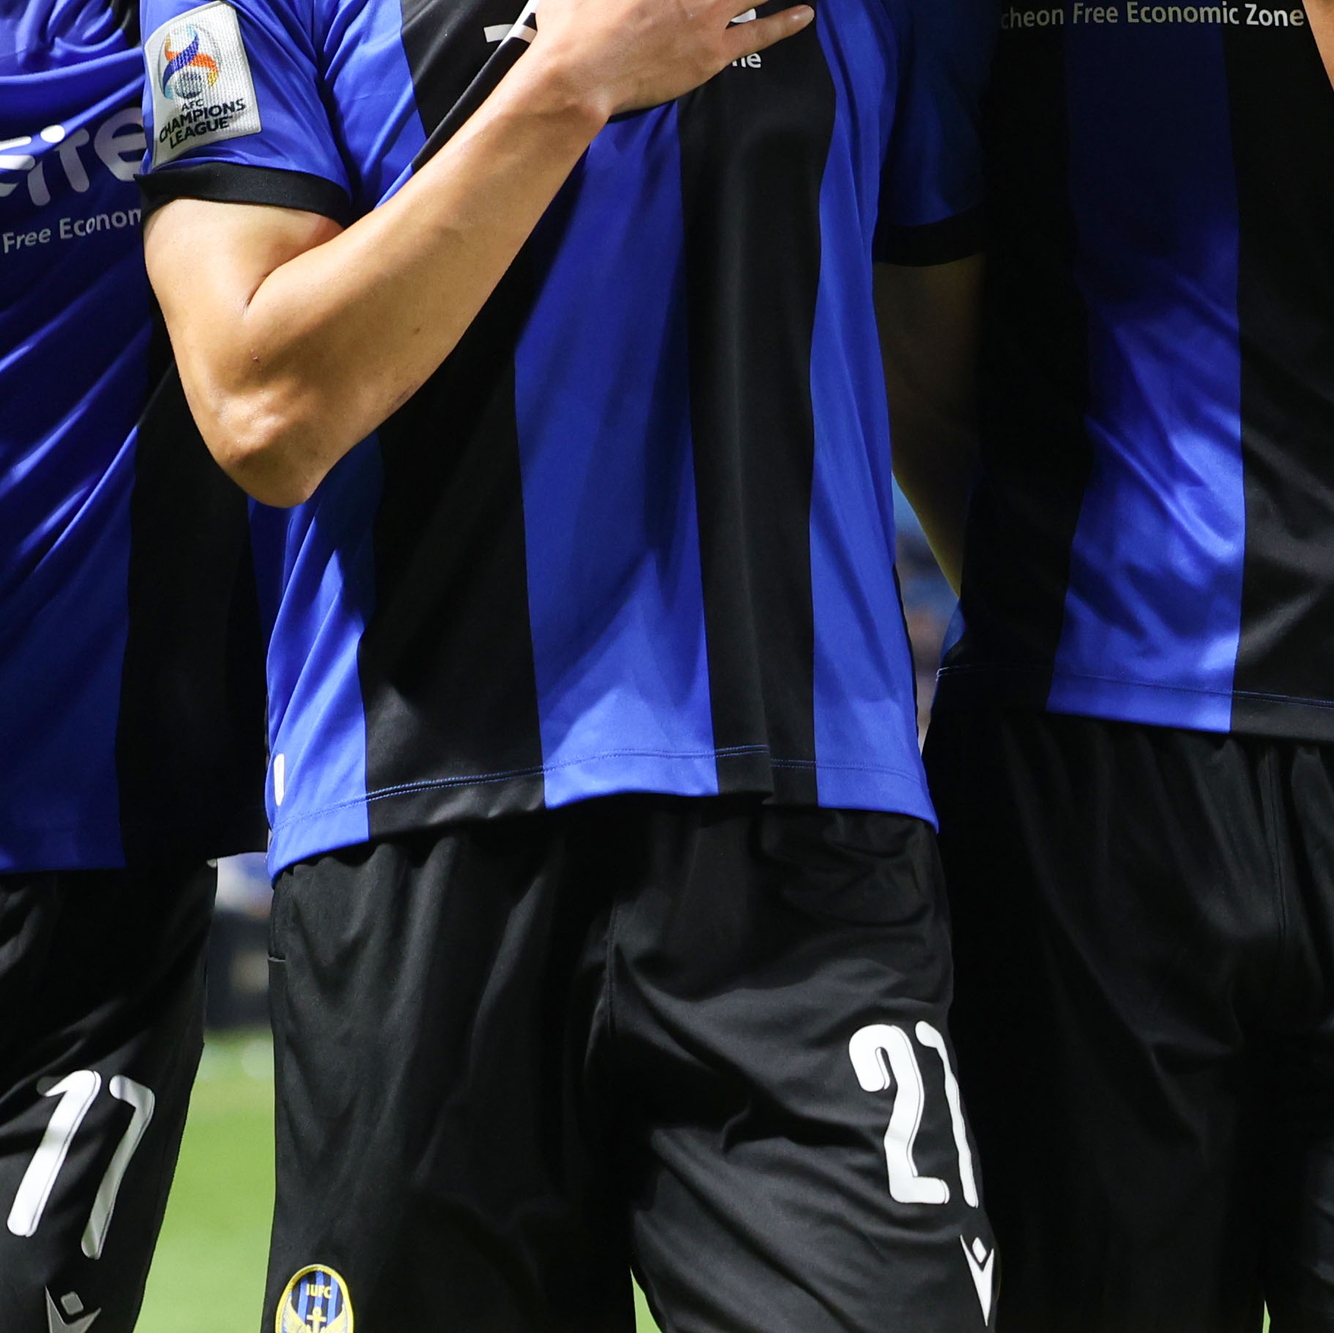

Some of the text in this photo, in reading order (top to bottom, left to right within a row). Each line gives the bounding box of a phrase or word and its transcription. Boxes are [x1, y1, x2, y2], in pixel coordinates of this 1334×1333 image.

[1000, 1, 1304, 30] cheon Free Economic Zone
[182, 98, 205, 112] AFC
[159, 97, 247, 144] CHAMPIONS
[169, 117, 230, 149] LEAGUE
[2, 227, 52, 254] Free
[59, 208, 142, 240] Econo
[306, 1283, 332, 1299] IUFC
